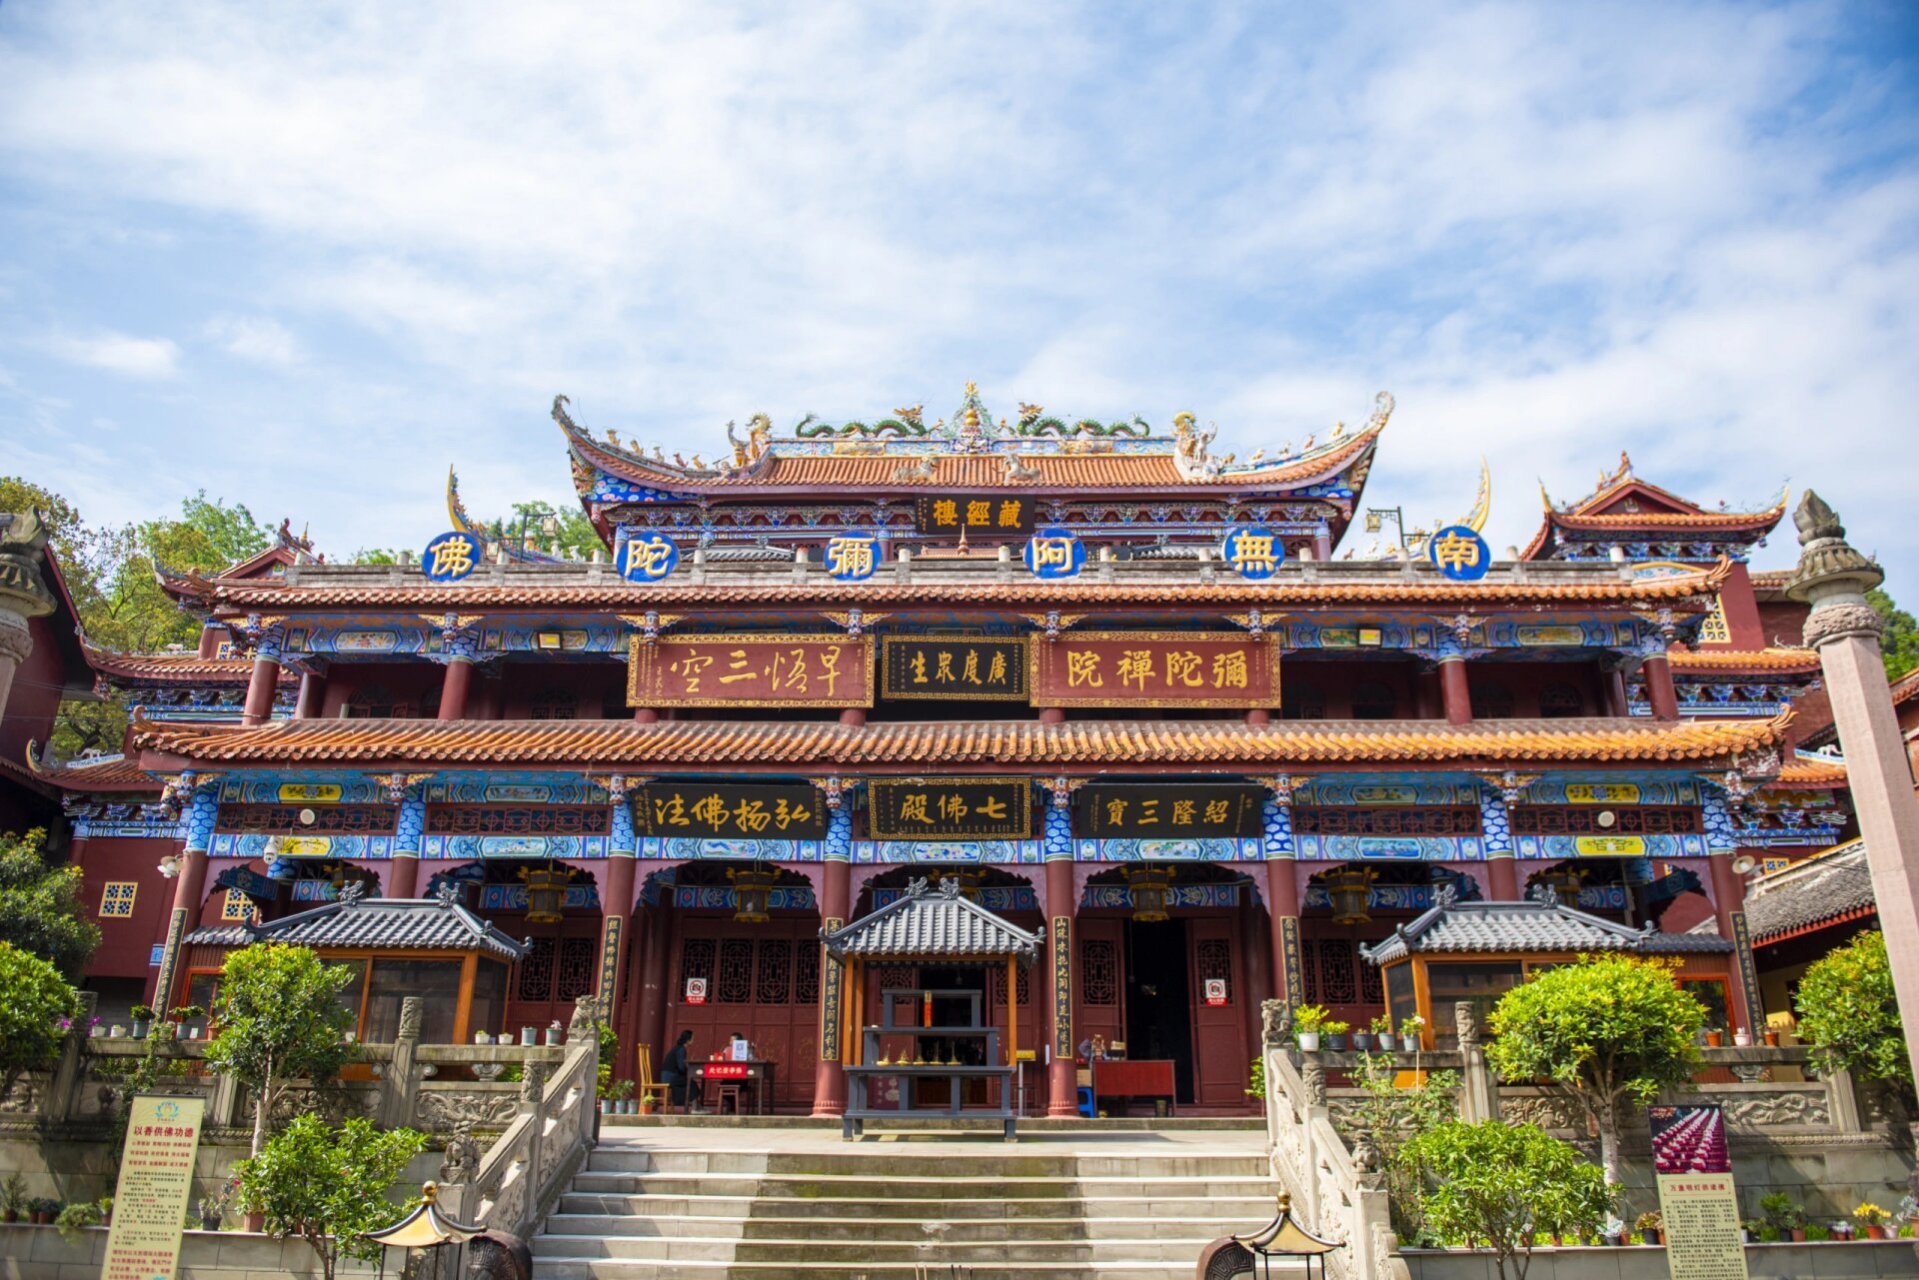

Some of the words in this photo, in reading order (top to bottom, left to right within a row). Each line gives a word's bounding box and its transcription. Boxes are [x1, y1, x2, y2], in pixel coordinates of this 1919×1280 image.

[933, 499, 1022, 528] 藏經樓
[430, 535, 473, 577] 佛
[625, 536, 672, 576] 陀
[829, 536, 876, 577] 彌
[1032, 536, 1076, 573] 阿
[1231, 529, 1280, 572] 無
[1435, 530, 1479, 572] 南
[1066, 650, 1249, 693] 彌陀禪院
[900, 794, 1008, 825] 七佛殿
